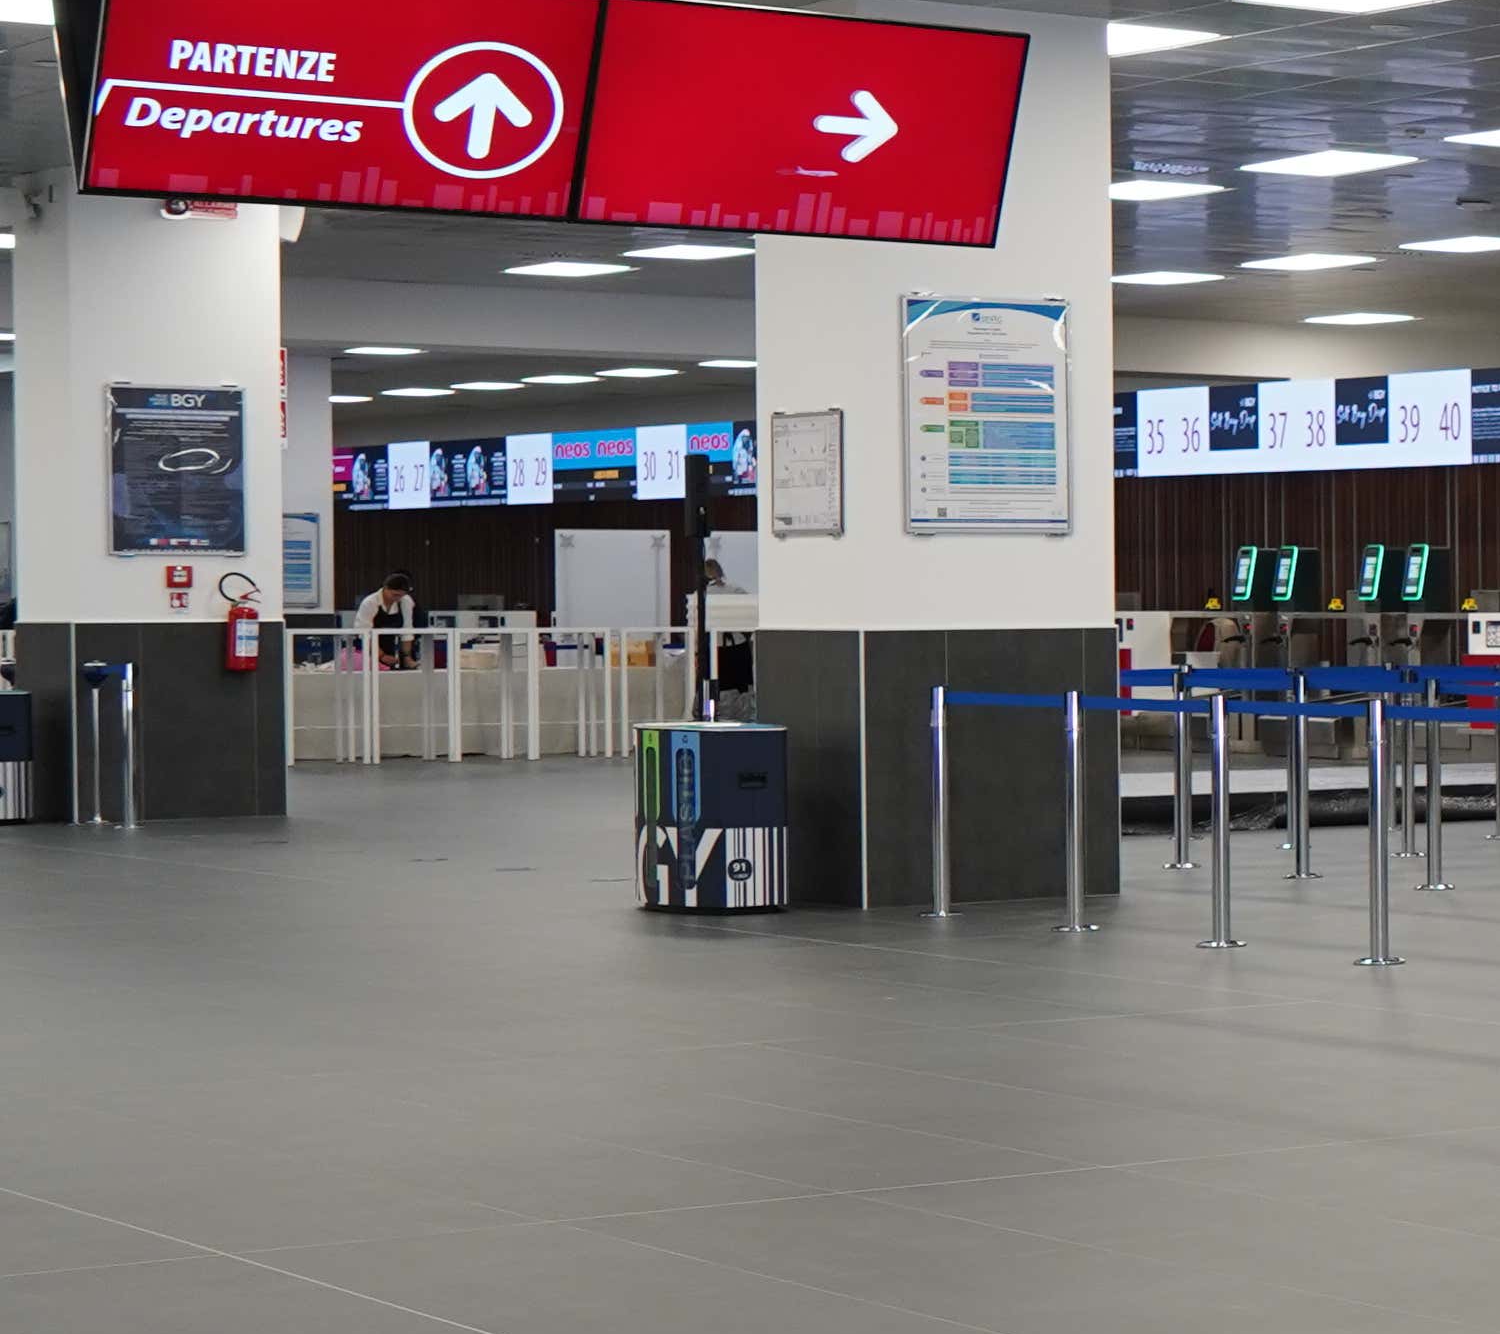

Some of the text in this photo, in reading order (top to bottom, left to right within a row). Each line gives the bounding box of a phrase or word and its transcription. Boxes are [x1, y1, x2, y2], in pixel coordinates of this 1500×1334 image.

[169, 39, 337, 82] PARTENZE
[124, 96, 363, 142] Departures
[171, 393, 206, 407] BGY
[1146, 417, 1201, 454] 35 36
[1268, 410, 1326, 449] 37 38
[1400, 405, 1421, 443] 39
[1439, 402, 1461, 441] 40
[554, 441, 590, 458] neos
[597, 438, 634, 456] neos
[689, 432, 729, 450] neos
[393, 464, 425, 492] 26 27
[512, 457, 548, 487] 28 29
[643, 450, 680, 481] 30 31
[731, 862, 747, 873] 91
